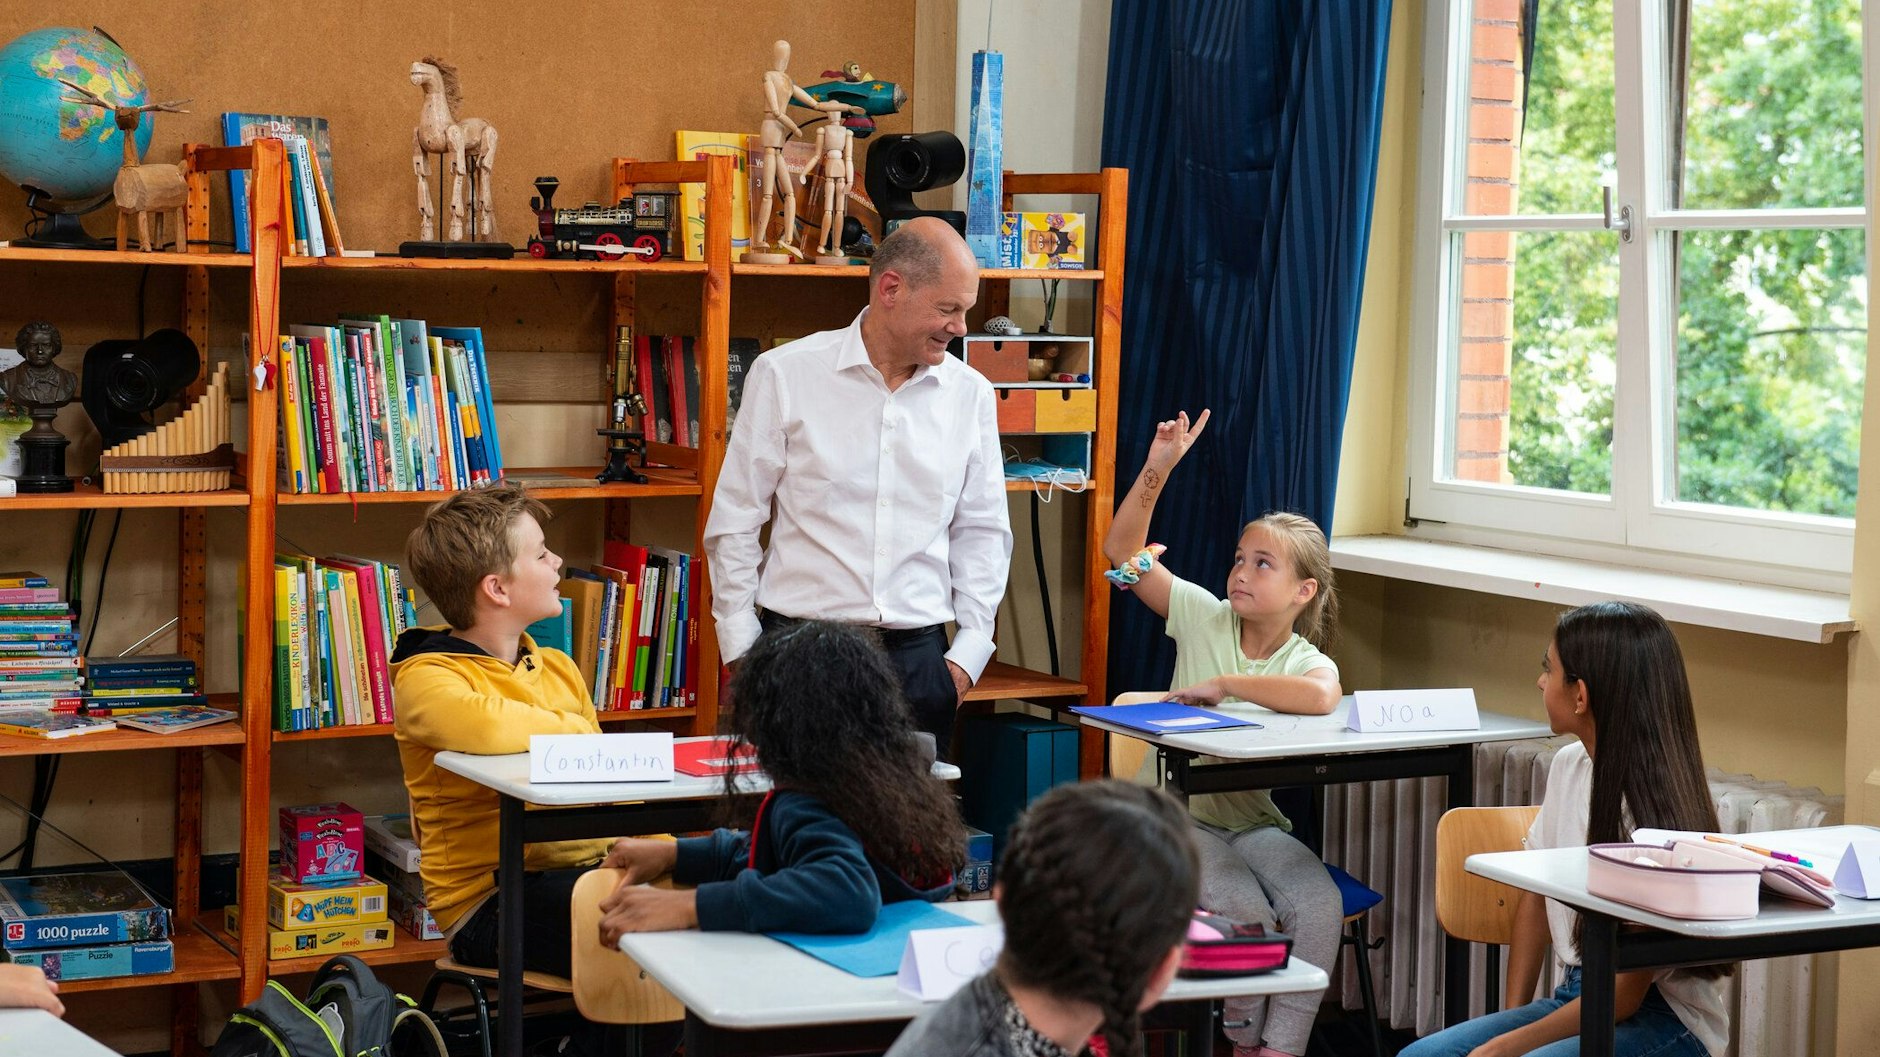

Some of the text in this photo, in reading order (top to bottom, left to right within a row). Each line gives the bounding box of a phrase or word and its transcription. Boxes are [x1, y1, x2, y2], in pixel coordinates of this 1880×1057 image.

[271, 121, 291, 132] Das
[1003, 235, 1014, 267] Mist,
[317, 363, 326, 389] Fantasie
[387, 369, 396, 396] GROSSE
[321, 402, 329, 418] Land
[390, 398, 398, 416] BUCH
[392, 416, 400, 432] DER
[325, 443, 334, 465] Komm
[394, 433, 405, 484] KINDERLIEDER
[290, 592, 299, 667] KINDERLEXIKON
[543, 743, 664, 775] Constantin
[315, 896, 354, 914] HÜPF MEIN
[323, 906, 357, 919] HÜTCHEN
[37, 924, 109, 941] 1000 puzzle
[88, 952, 114, 960] Puzzle
